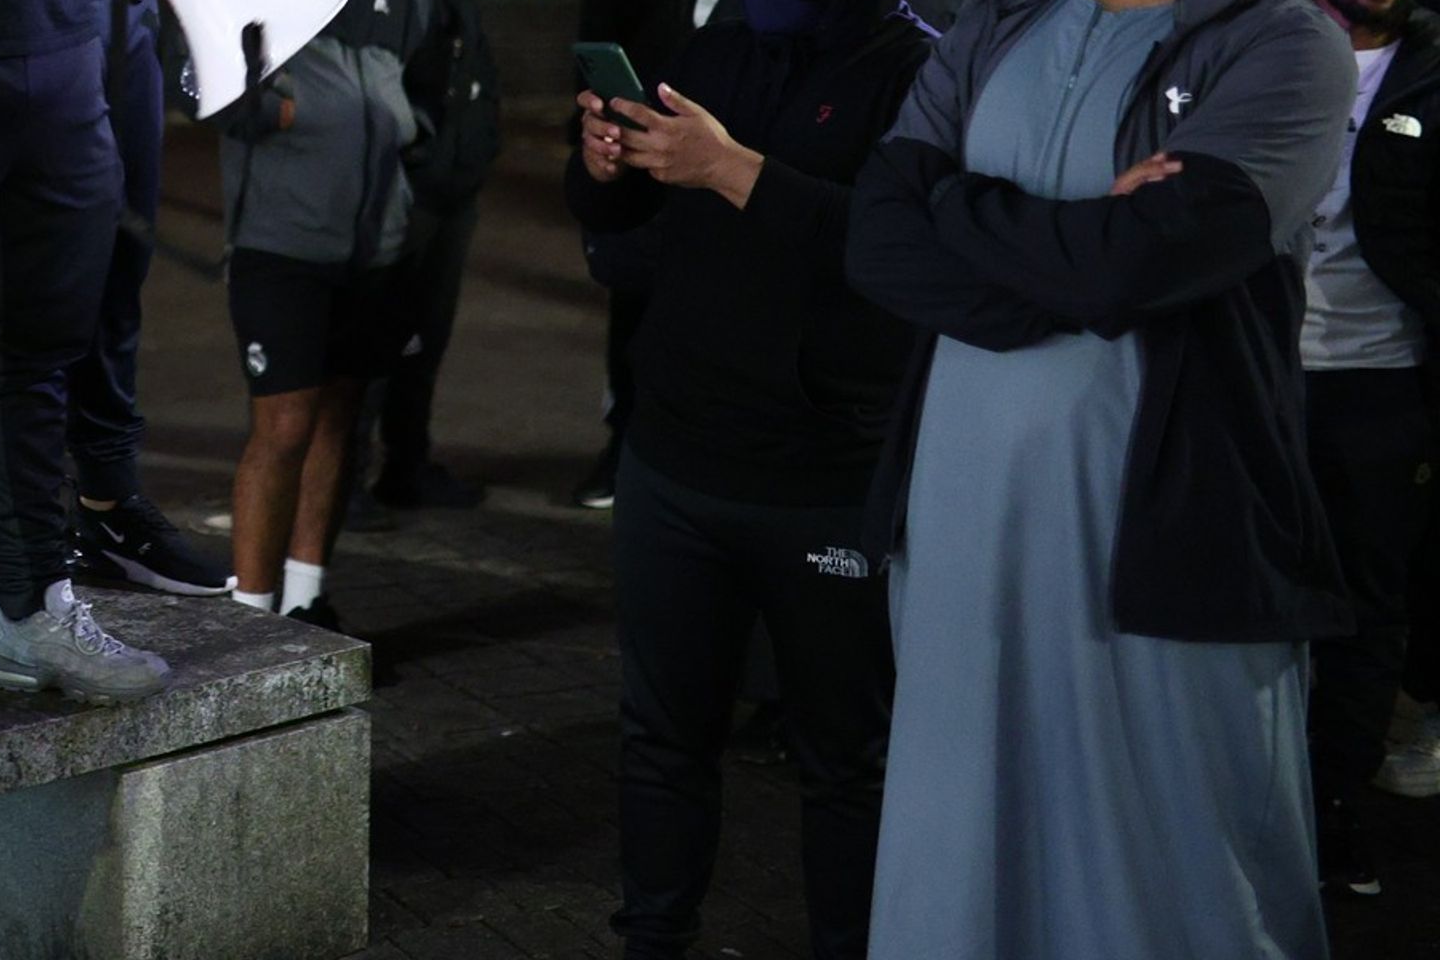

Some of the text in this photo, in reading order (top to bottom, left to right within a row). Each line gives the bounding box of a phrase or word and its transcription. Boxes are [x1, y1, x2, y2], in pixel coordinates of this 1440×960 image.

[826, 546, 848, 558] THE
[806, 552, 849, 568] NORTH
[819, 562, 846, 576] FACE
